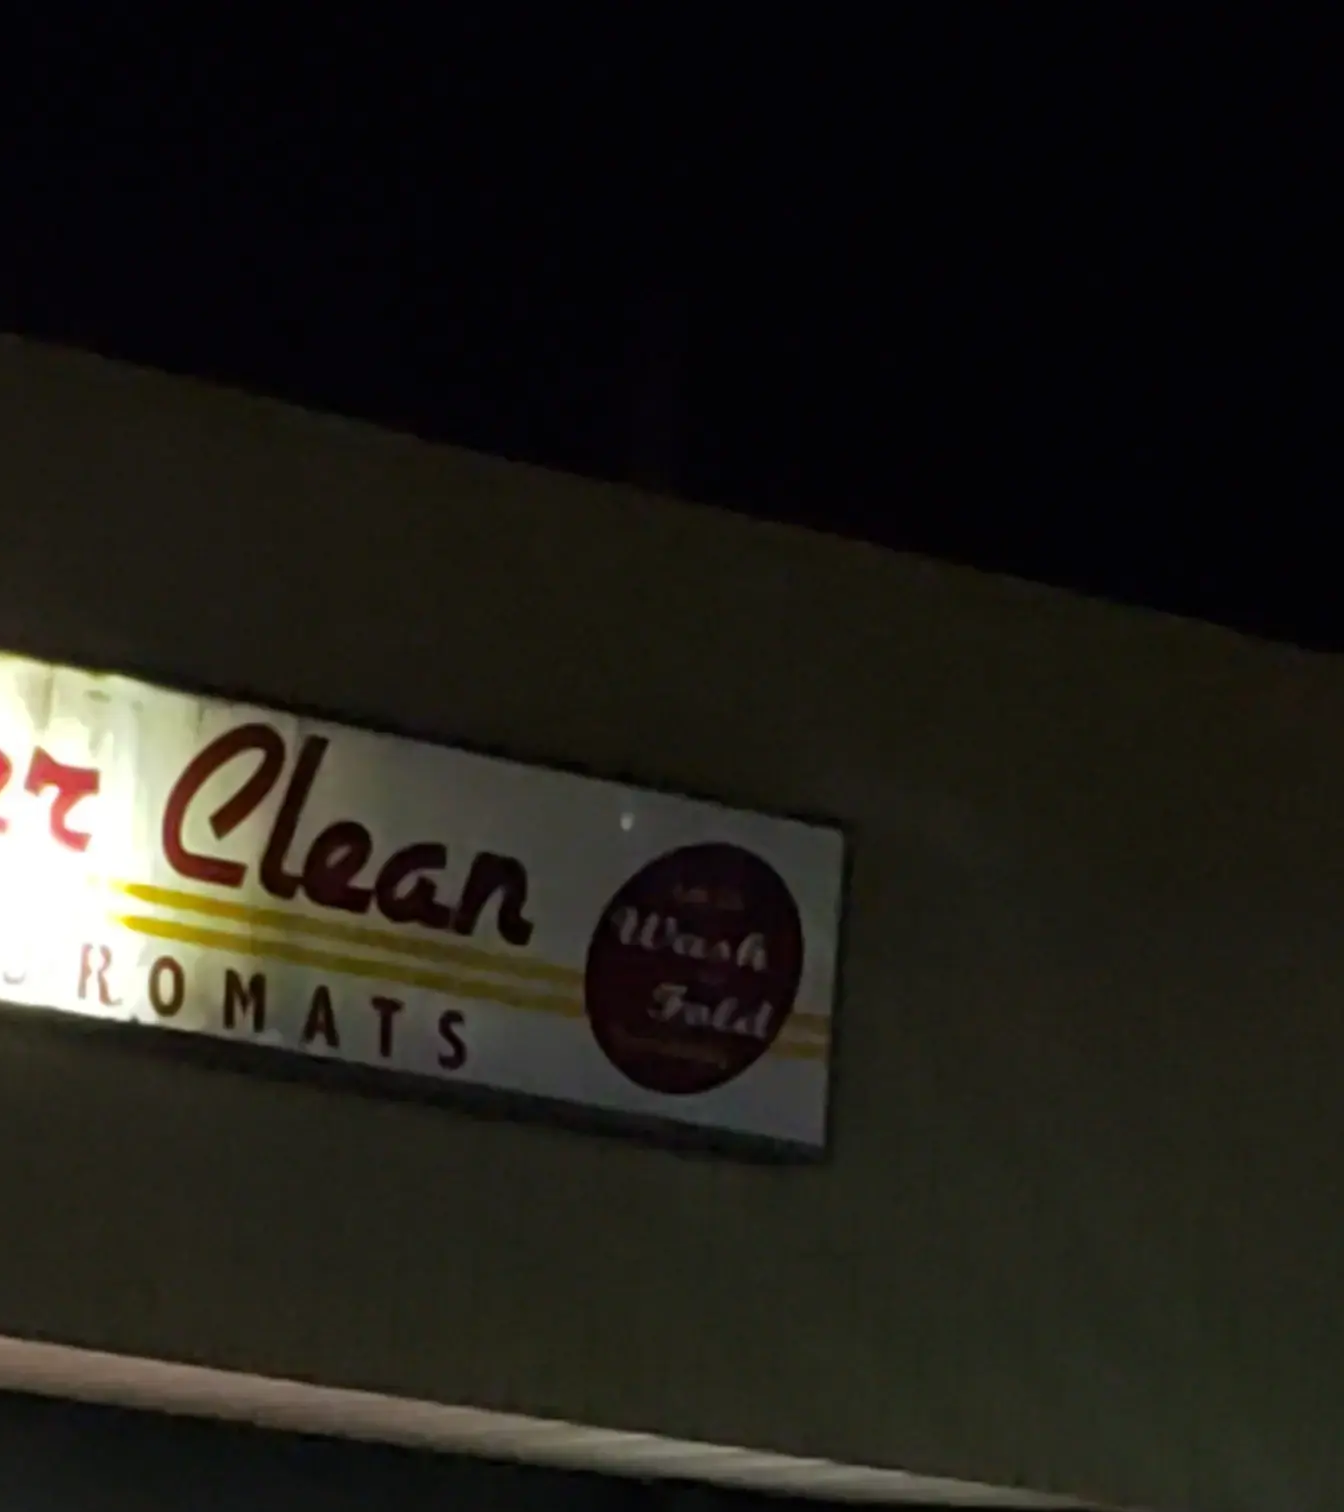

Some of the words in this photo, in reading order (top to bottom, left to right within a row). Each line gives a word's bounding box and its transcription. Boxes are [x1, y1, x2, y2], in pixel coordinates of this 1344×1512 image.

[162, 722, 534, 946] Clean
[610, 904, 769, 973] Wash
[646, 982, 775, 1039] Fold
